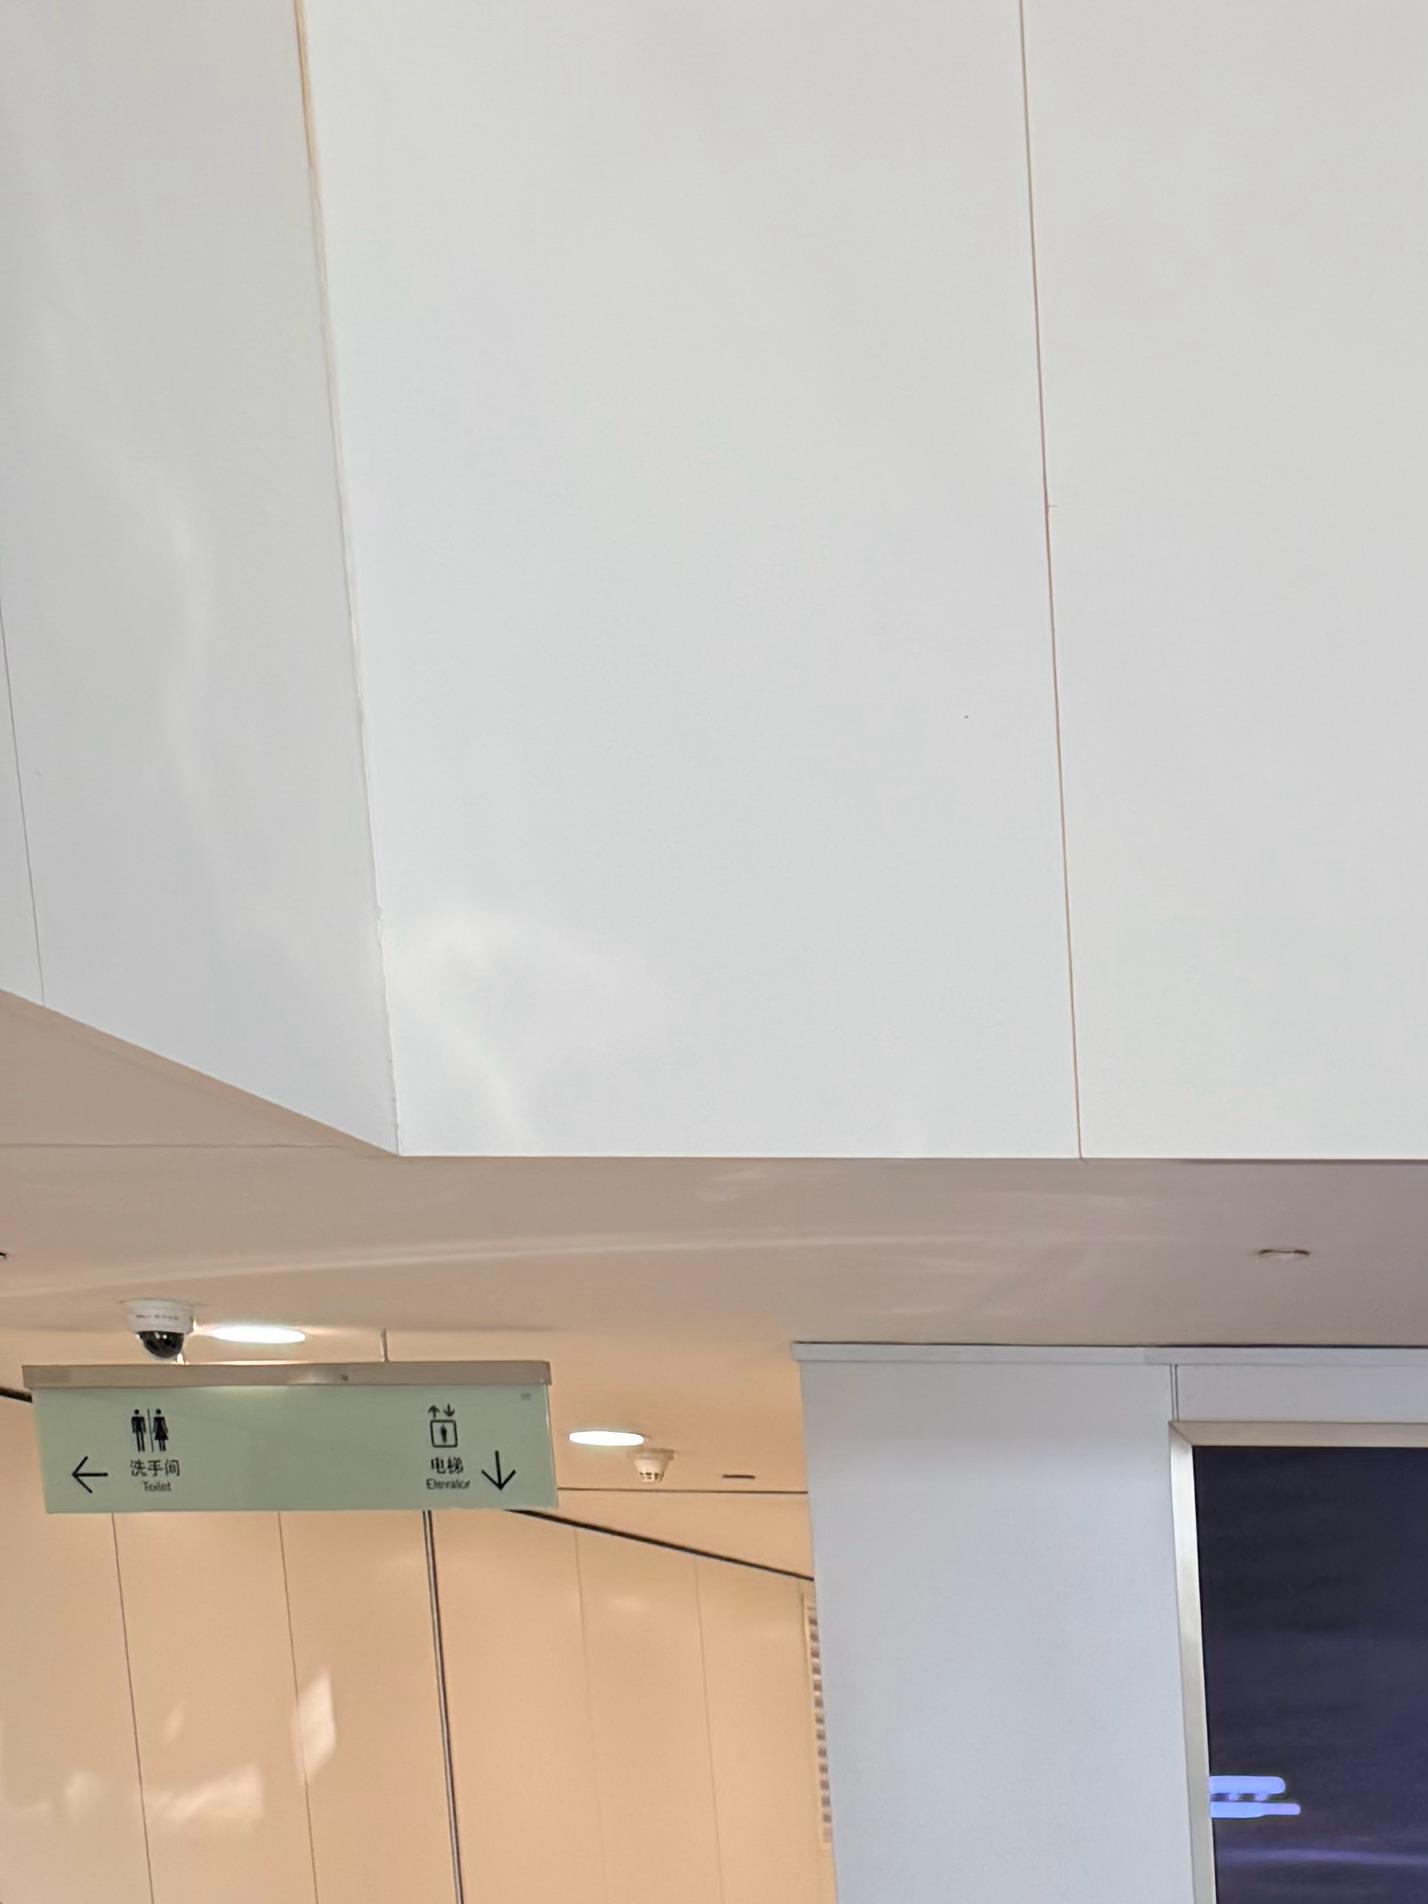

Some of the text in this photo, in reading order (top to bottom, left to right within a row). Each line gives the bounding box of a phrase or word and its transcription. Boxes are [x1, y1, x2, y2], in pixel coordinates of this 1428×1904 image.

[130, 1459, 180, 1477] 洗手间
[431, 1456, 464, 1475] 电梯
